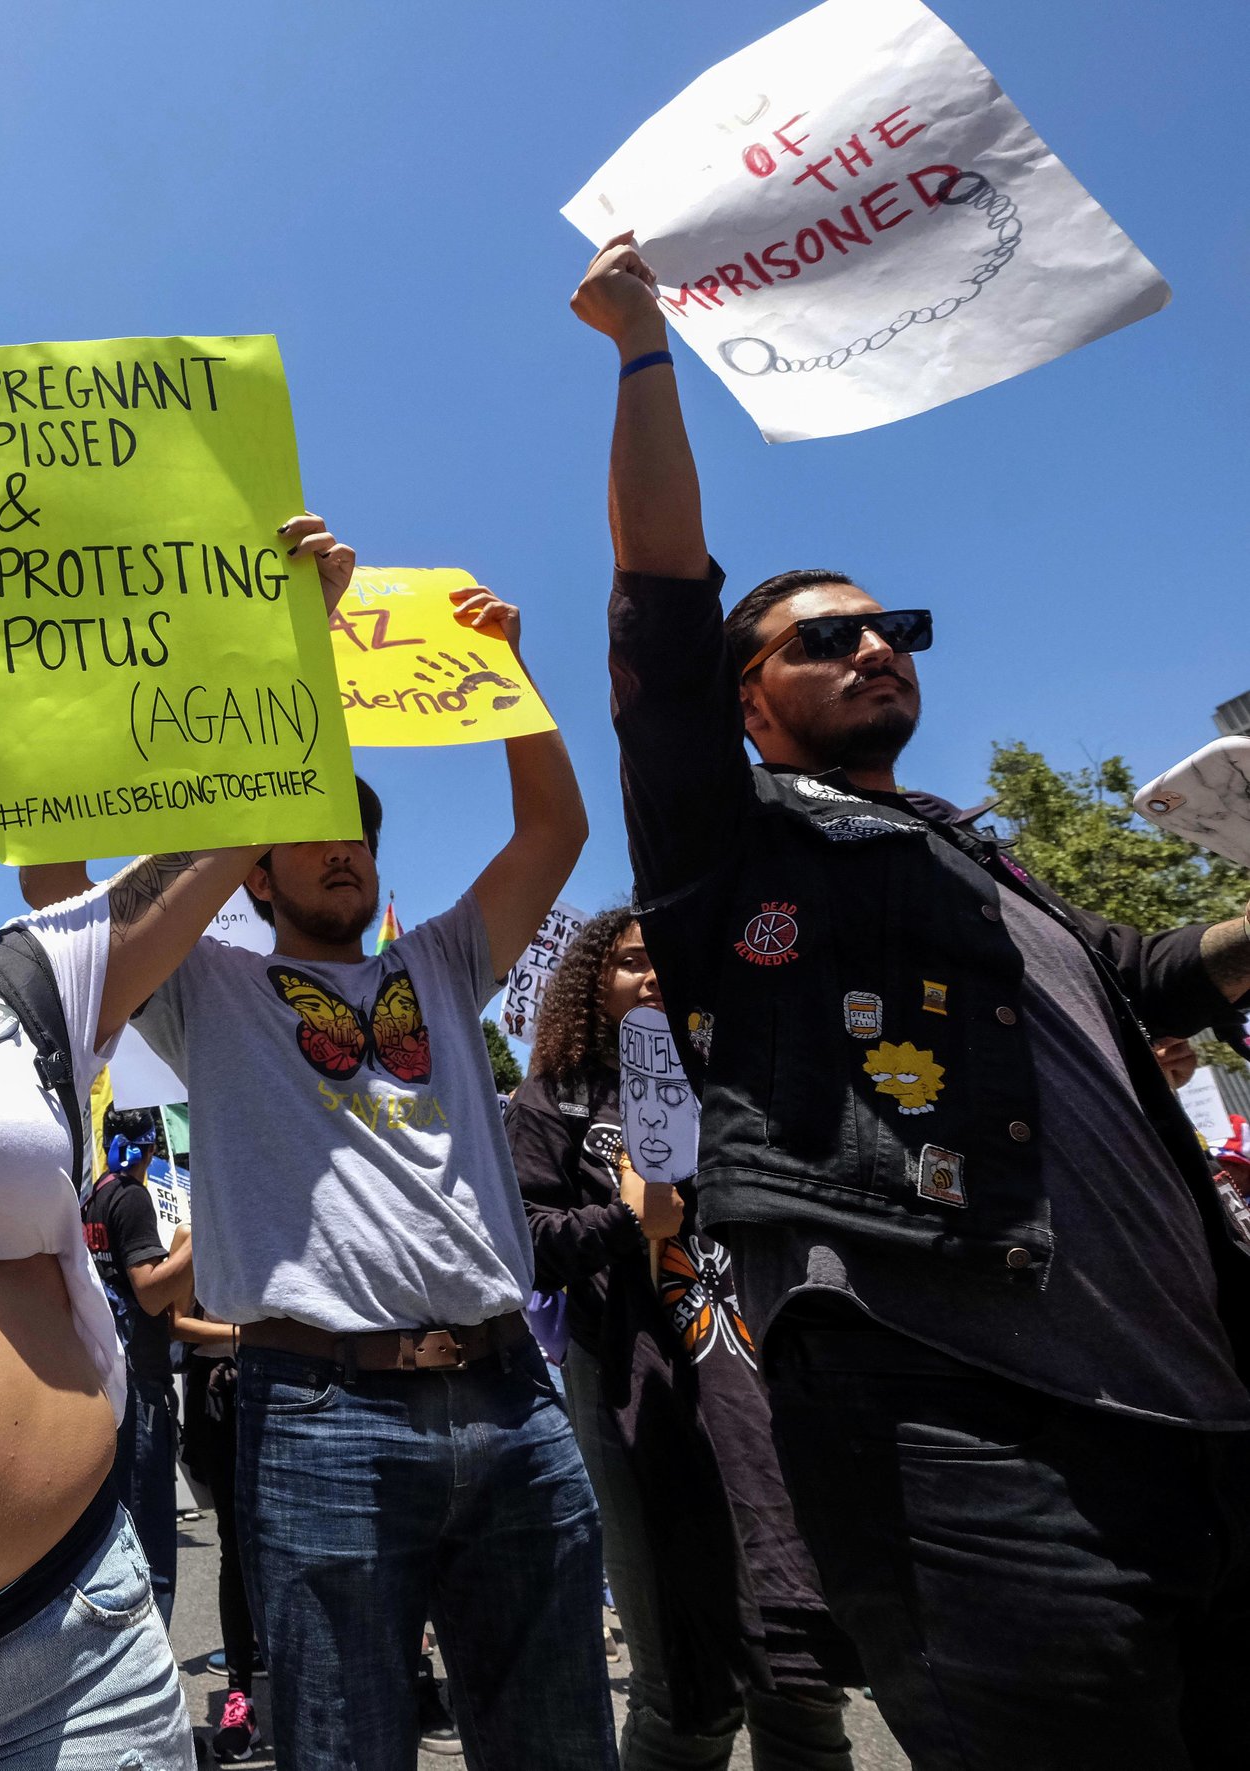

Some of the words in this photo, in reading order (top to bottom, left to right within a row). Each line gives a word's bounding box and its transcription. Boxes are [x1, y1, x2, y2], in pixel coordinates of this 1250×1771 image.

[742, 110, 811, 179] OF
[792, 105, 927, 192] THE
[4, 610, 170, 673] POTUS
[130, 678, 319, 764] (AGAIN)
[761, 901, 798, 916] DEAD
[734, 940, 799, 966] KENNEDYS
[684, 1282, 706, 1308] UP
